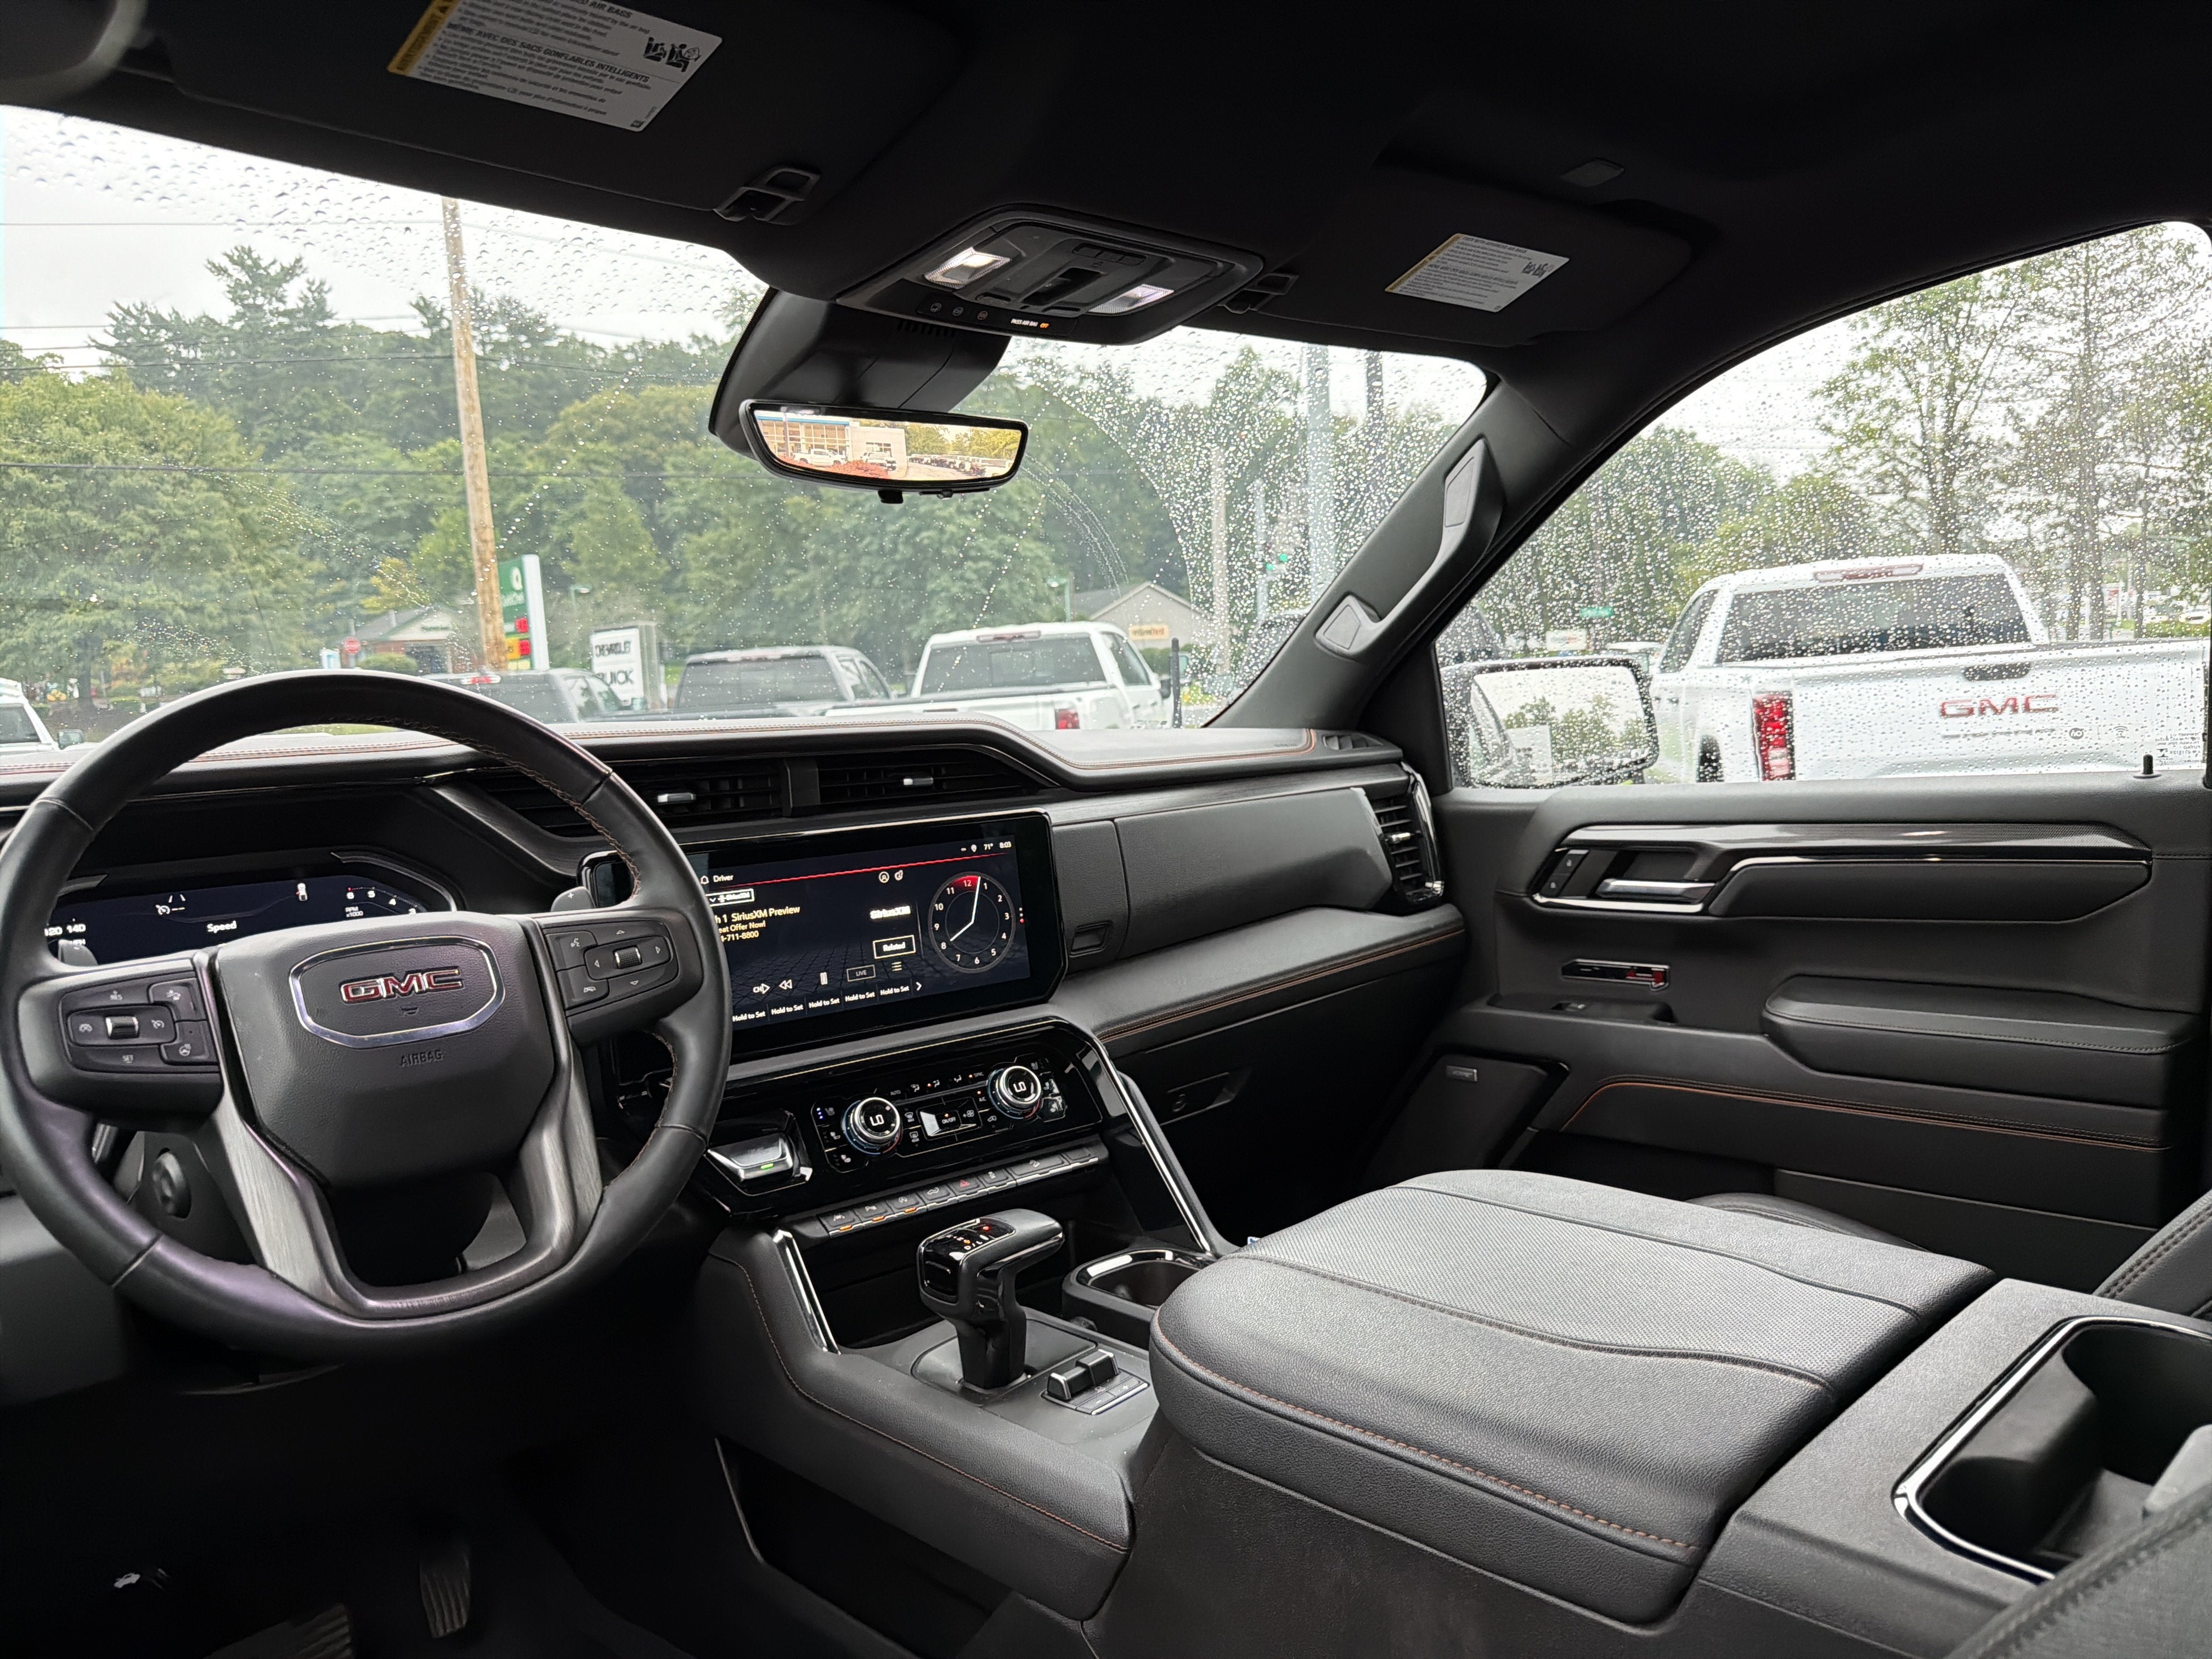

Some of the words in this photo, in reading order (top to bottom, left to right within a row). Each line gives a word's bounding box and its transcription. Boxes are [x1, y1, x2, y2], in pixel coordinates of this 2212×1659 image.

[607, 6, 633, 18] BAGS
[474, 30, 501, 41] AVEC
[498, 36, 520, 46] DES
[517, 41, 544, 53] SACS
[593, 62, 653, 83] INTELLIGENTS
[511, 567, 523, 591] Q
[1940, 693, 2058, 718] GMC
[963, 879, 972, 887] 12
[347, 891, 354, 900] 6
[870, 905, 911, 919] SiriusXM
[934, 902, 944, 911] 10
[723, 913, 728, 923] 1
[731, 909, 768, 922] SiriusXM
[769, 906, 801, 917] Preview
[1005, 912, 1009, 920] 3
[44, 926, 63, 936] 120
[66, 923, 86, 933] 140
[207, 920, 237, 934] Speed
[730, 922, 748, 932] Offer
[749, 919, 766, 929] Now!
[882, 941, 906, 952] Related
[941, 941, 946, 950] 8
[340, 967, 462, 1003] GMC
[879, 988, 893, 996] Hold
[400, 1050, 443, 1066] AIRBAG
[941, 1116, 956, 1125] ON/OFF
